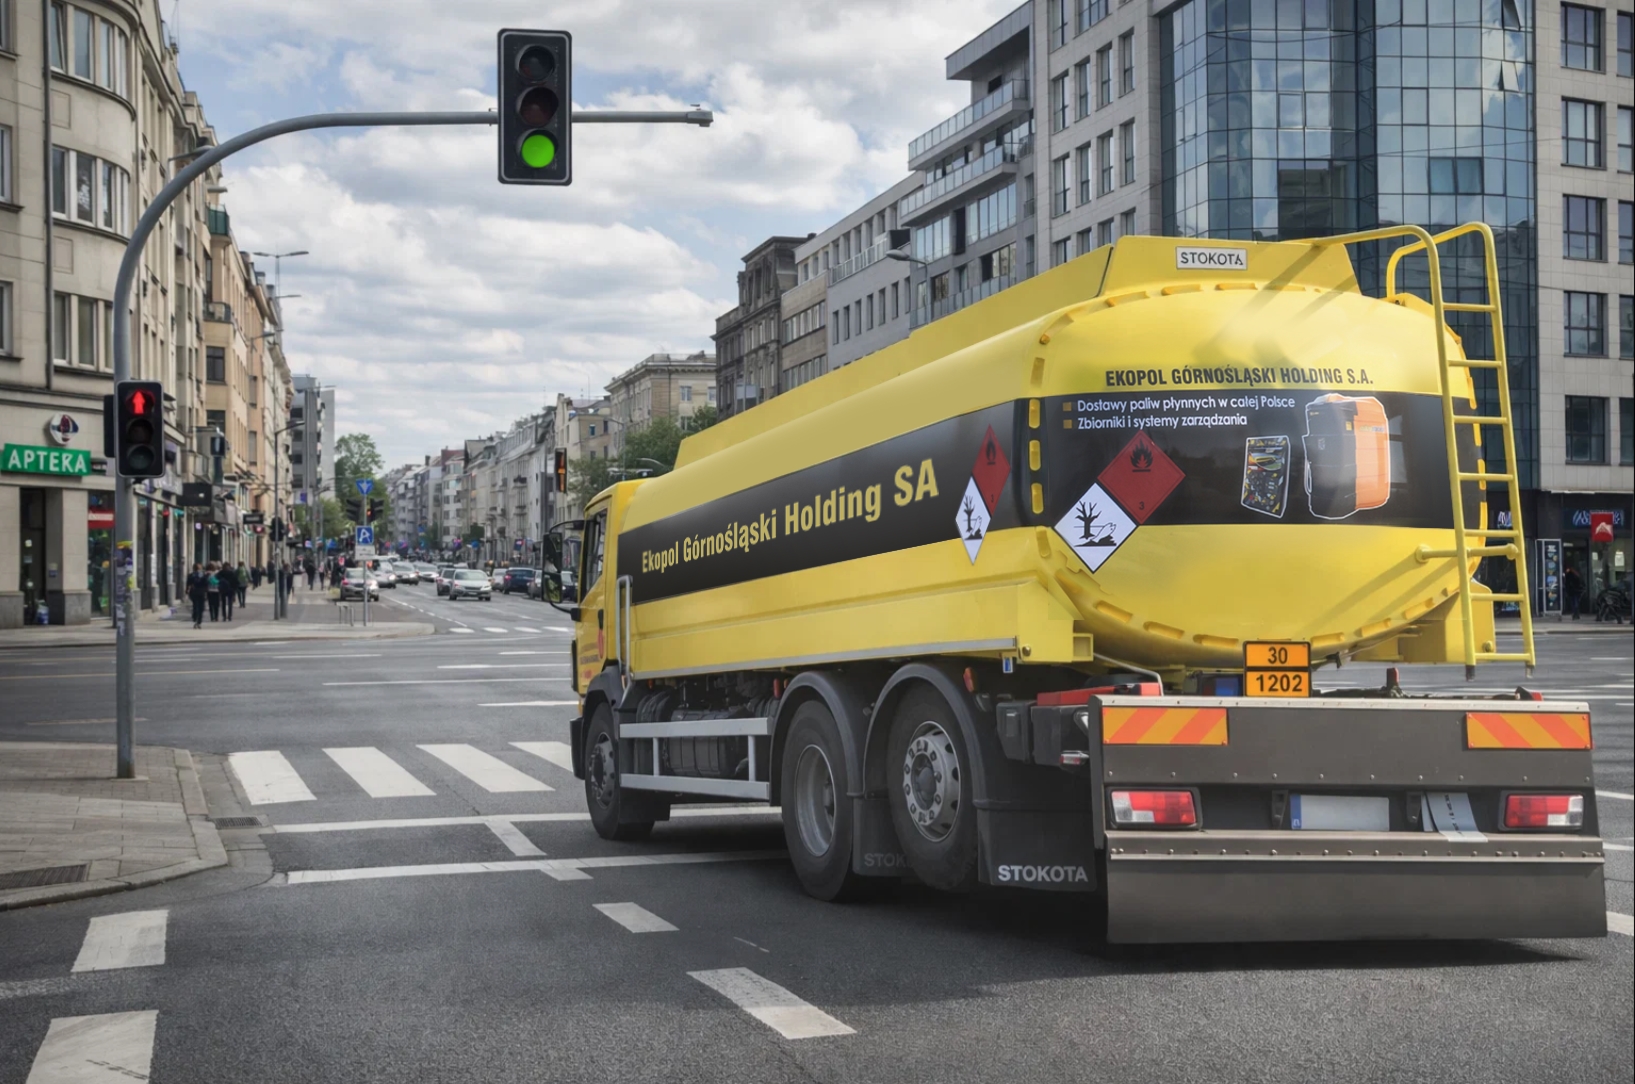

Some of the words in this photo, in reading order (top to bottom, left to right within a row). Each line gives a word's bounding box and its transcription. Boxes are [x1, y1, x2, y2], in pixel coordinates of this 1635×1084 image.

[1180, 251, 1243, 266] STOKOTA
[1105, 369, 1167, 387] EKOPOL
[1171, 365, 1276, 387] GÓRNOŚLĄSKI
[1280, 367, 1343, 384] HOLDING
[1346, 368, 1374, 384] S.A.
[1077, 399, 1127, 413] Dostawy
[1130, 397, 1160, 413] paliw
[1163, 396, 1216, 412] płynnych
[1218, 398, 1228, 408] w
[1230, 395, 1259, 410] całej
[1261, 395, 1296, 408] Polsce
[1077, 416, 1126, 430] Zbiorniki
[1127, 415, 1132, 428] i
[1133, 414, 1179, 430] systemy
[1181, 413, 1248, 428] zarządzania
[8, 448, 87, 473] APTEKA
[1138, 501, 1145, 510] 3
[642, 540, 679, 574] Ekopol
[683, 508, 777, 562] Górnośląski
[785, 483, 882, 536] Holding
[894, 458, 939, 507] SA
[1267, 646, 1288, 665] 30
[1256, 673, 1303, 692] 1202
[998, 864, 1089, 882] STOKOTA
